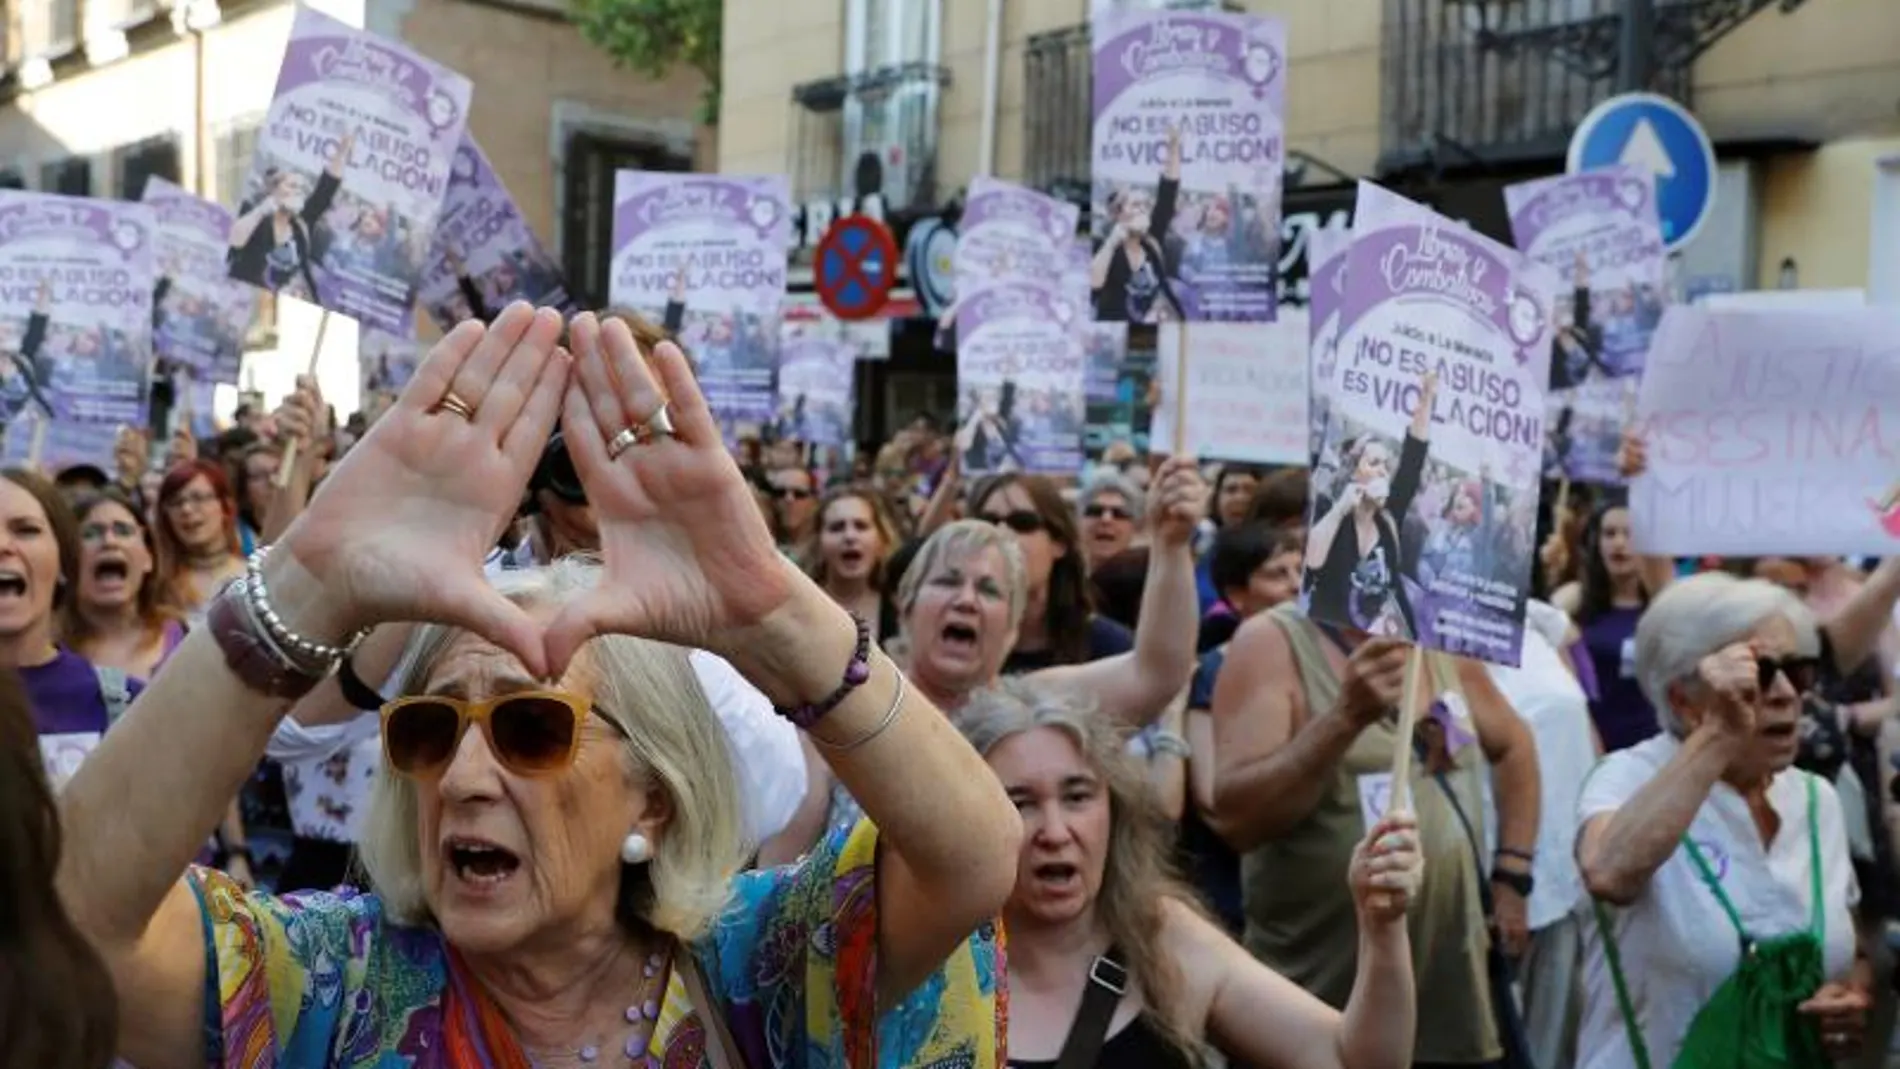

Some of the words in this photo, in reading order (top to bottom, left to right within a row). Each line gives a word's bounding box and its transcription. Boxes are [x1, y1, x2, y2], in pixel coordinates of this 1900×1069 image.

[1180, 112, 1261, 136] ABUSO
[1342, 369, 1369, 394] ES
[1399, 348, 1428, 376] ES
[1436, 356, 1521, 408] ABUSO
[1708, 345, 1900, 403] JUSTIC
